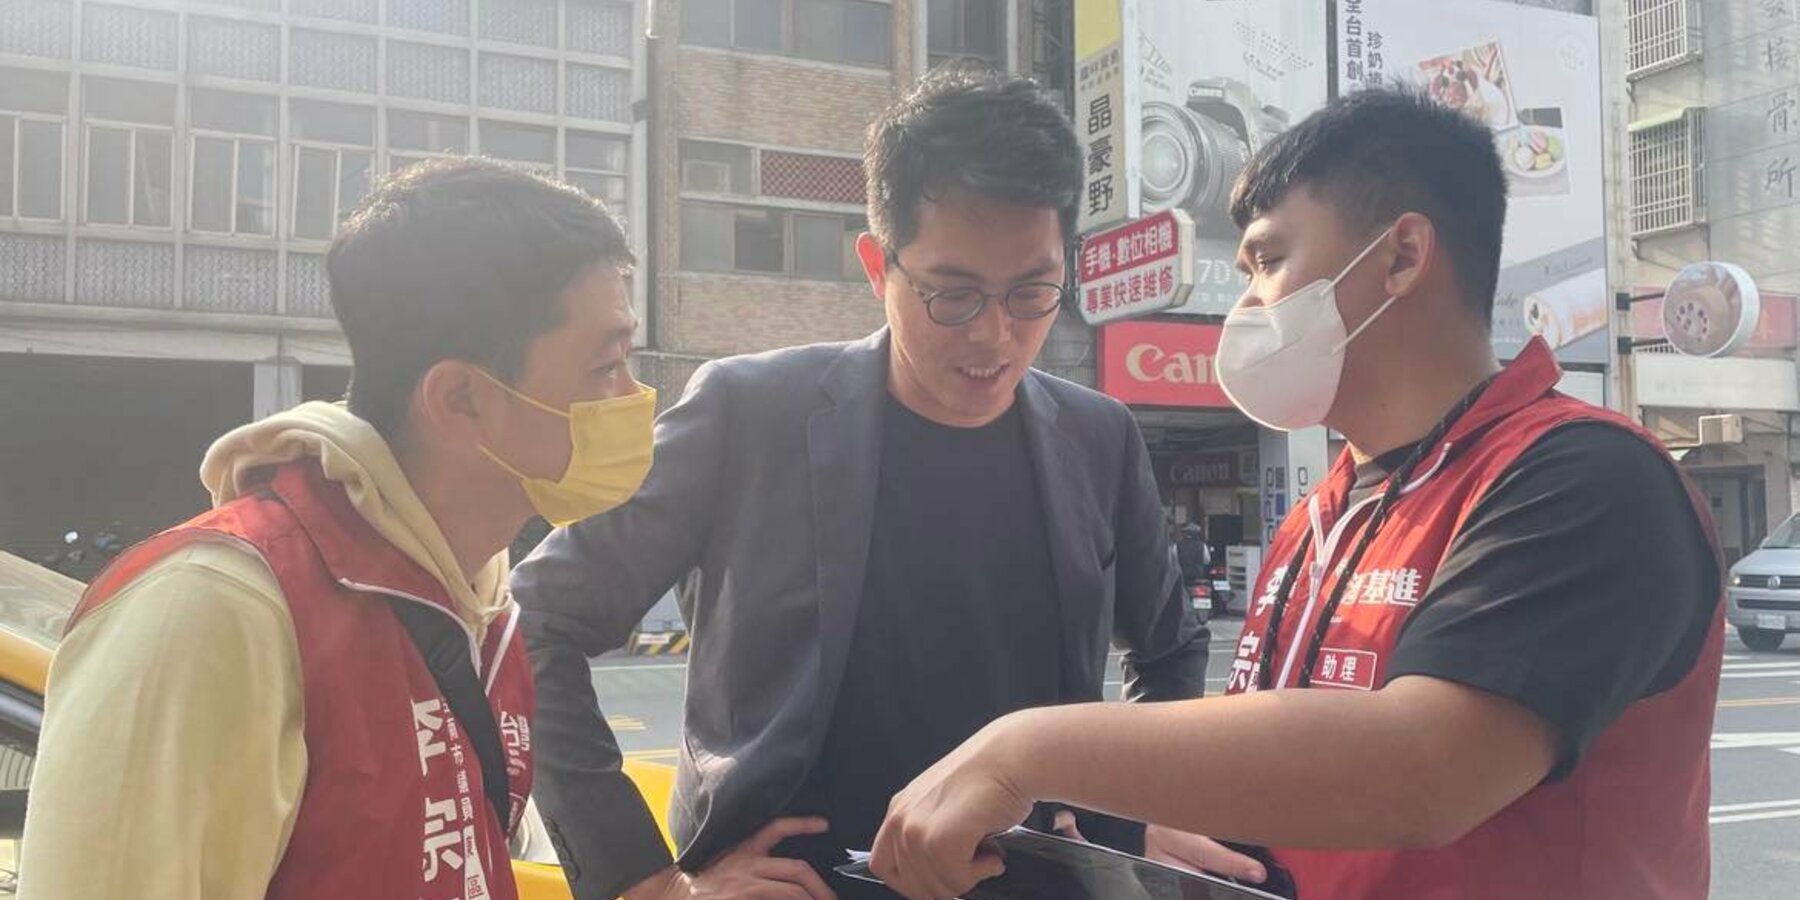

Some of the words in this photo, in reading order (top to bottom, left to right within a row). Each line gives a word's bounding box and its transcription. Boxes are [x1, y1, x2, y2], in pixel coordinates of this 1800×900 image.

[1345, 0, 1363, 89] 全台首創
[1088, 94, 1113, 216] 晶豪野
[1085, 265, 1173, 314] 專業快速維修
[1197, 259, 1231, 284] 7D
[1126, 343, 1218, 384] Can
[1321, 653, 1357, 681] 助理
